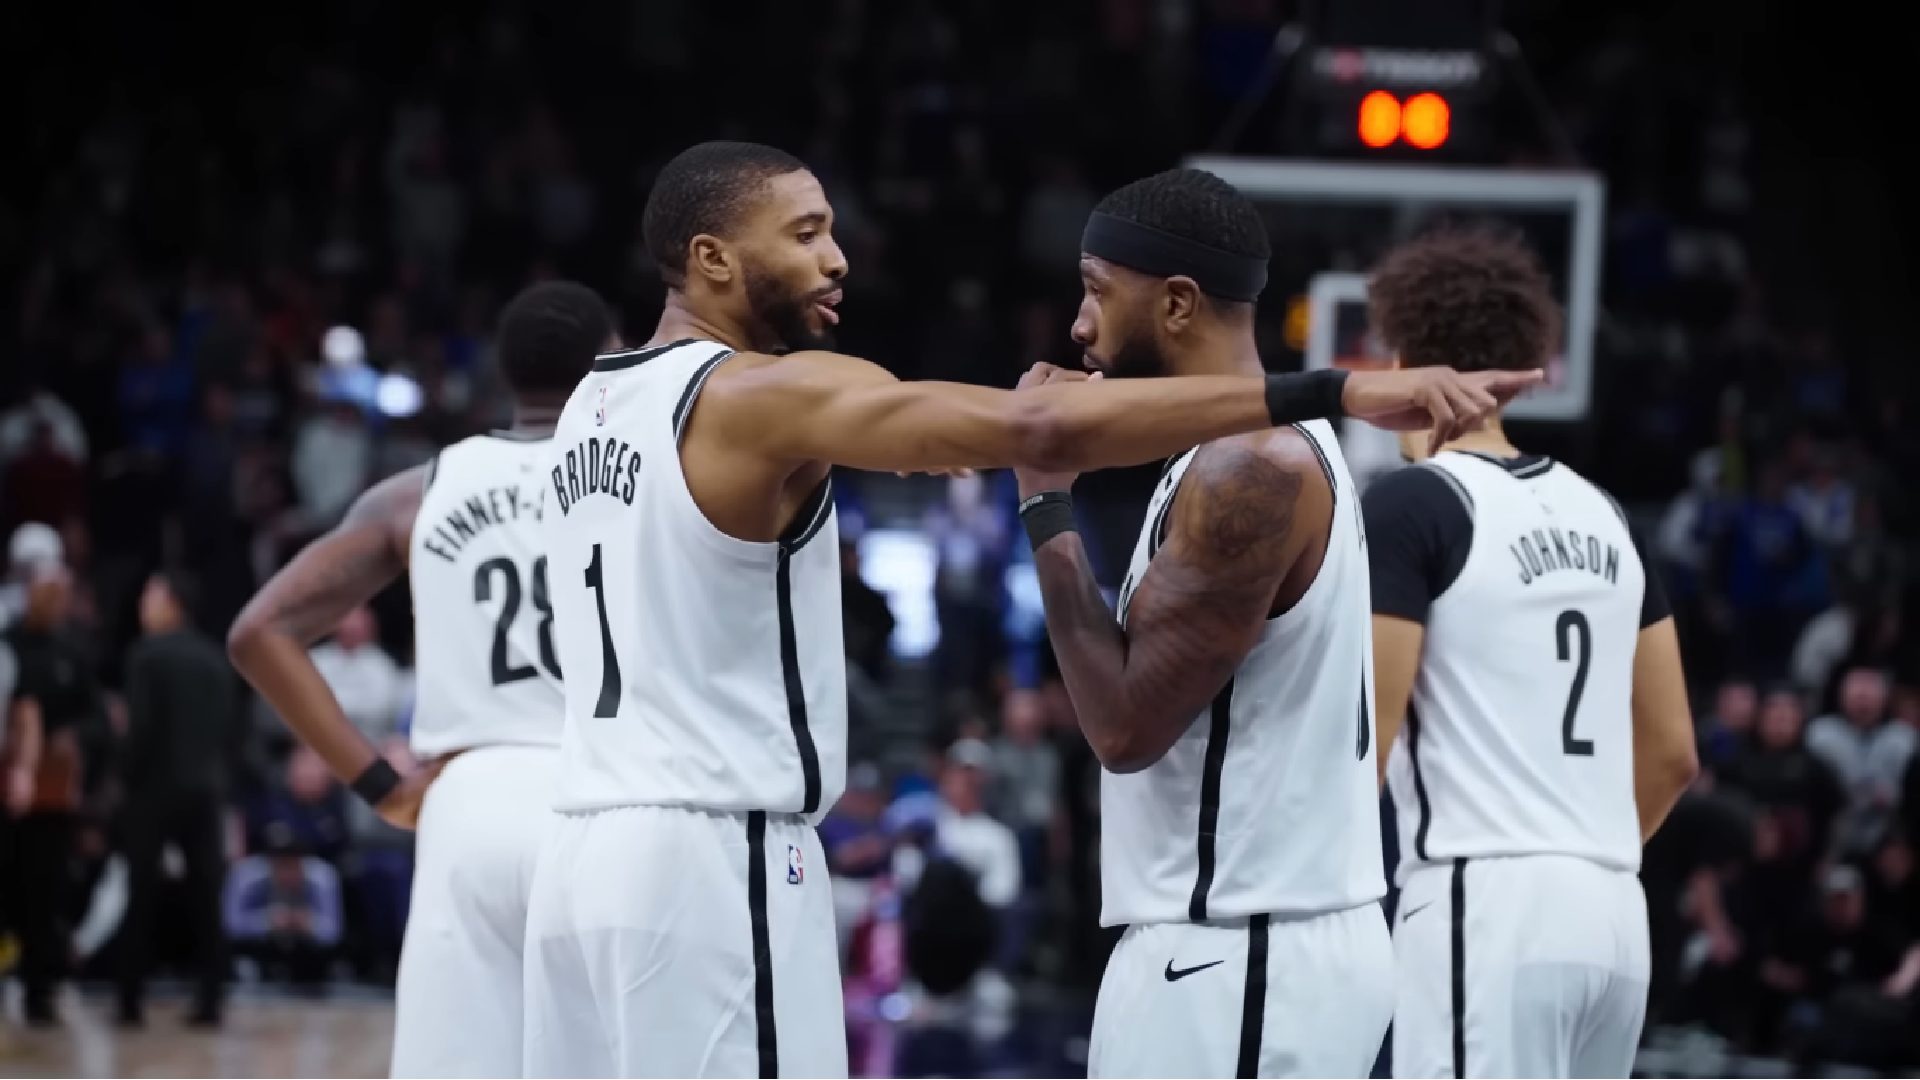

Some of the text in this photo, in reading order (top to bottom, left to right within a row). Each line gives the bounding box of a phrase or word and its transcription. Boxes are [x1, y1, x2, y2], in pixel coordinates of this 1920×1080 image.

[551, 437, 641, 517] BRIDGES
[1510, 527, 1620, 586] JOHNSON
[584, 543, 621, 718] 1
[1556, 608, 1595, 756] 2
